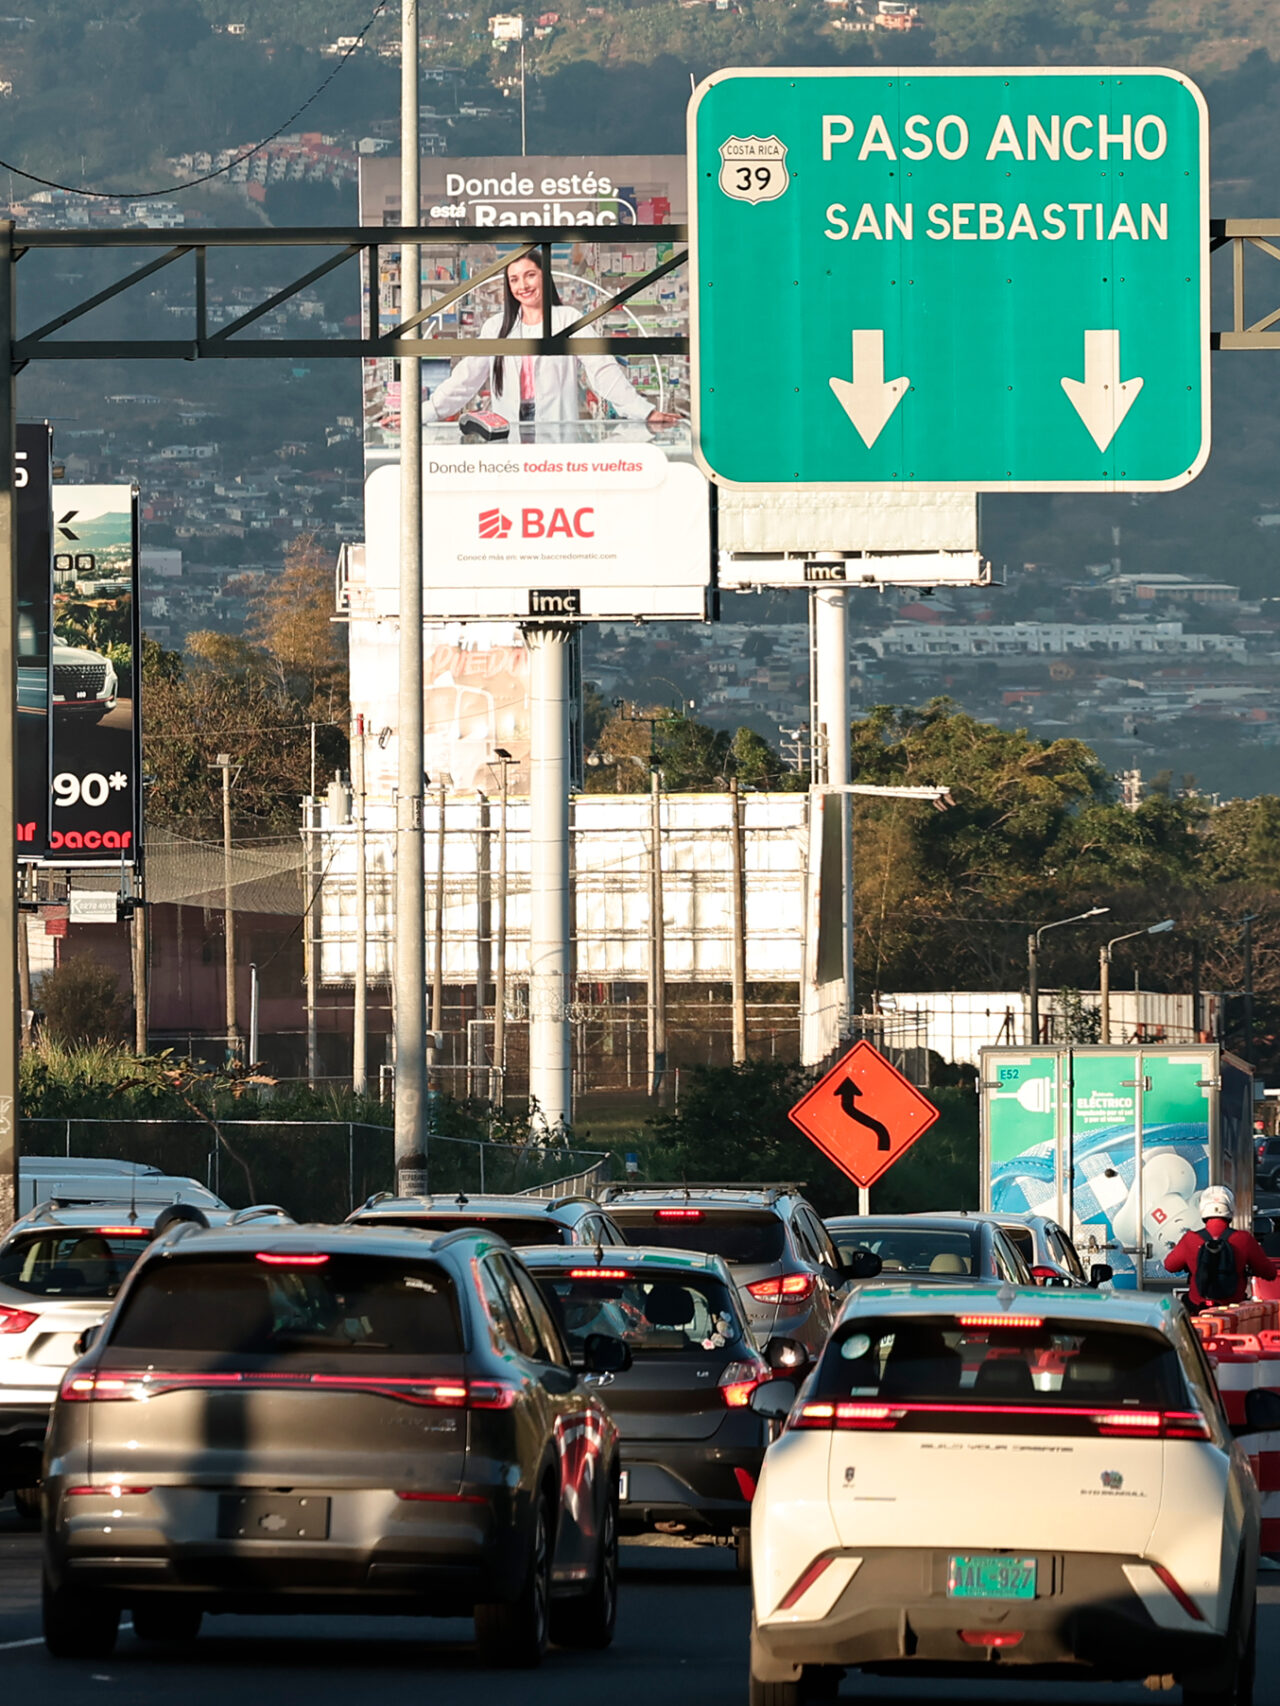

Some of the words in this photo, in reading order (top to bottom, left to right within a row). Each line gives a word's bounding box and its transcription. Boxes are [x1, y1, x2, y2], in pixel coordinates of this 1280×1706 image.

[822, 114, 969, 161] PASO
[986, 114, 1168, 161] ANCHO
[727, 145, 755, 155] COSTA
[758, 145, 779, 155] RICA
[446, 172, 534, 197] Donde
[540, 171, 619, 198] estés,
[736, 167, 771, 191] 39
[430, 202, 466, 218] está
[824, 203, 913, 240] SAN
[926, 203, 1168, 240] SEBASTIAN
[429, 461, 475, 474] Donde
[478, 460, 520, 474] hacés
[523, 460, 563, 473] todas
[566, 461, 589, 473] tus
[591, 459, 643, 473] vueltas
[521, 507, 595, 539] BAC
[532, 591, 577, 613] imc
[1000, 1069, 1019, 1080] E52
